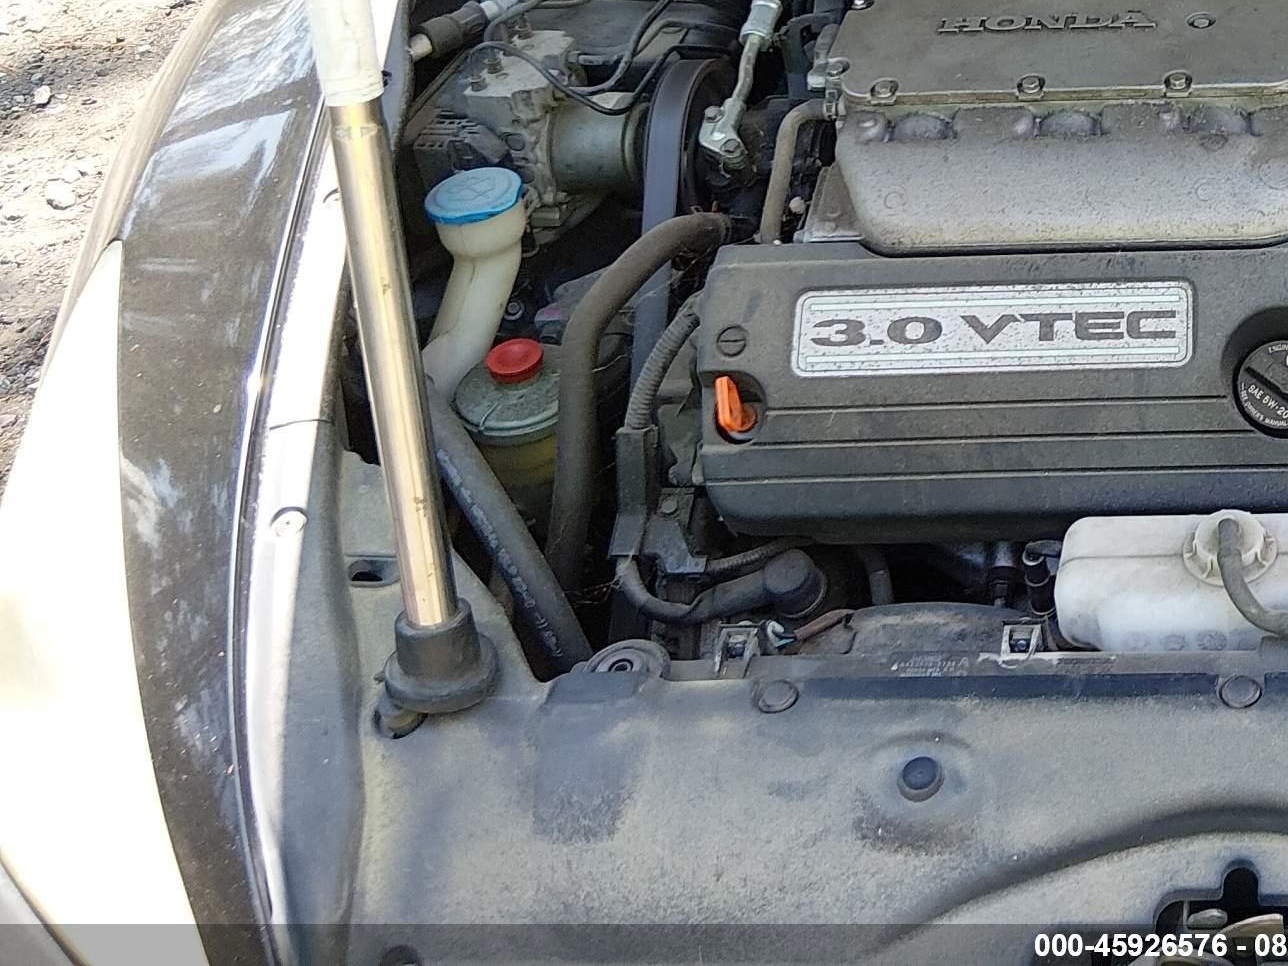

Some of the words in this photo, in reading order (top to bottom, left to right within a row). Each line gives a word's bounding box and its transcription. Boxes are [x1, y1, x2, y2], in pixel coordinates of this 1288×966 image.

[936, 10, 1157, 33] HONDA
[811, 314, 942, 347] 3.0
[960, 309, 1177, 344] VTEC
[1248, 384, 1264, 399] SAE
[1264, 417, 1288, 427] MANUAL
